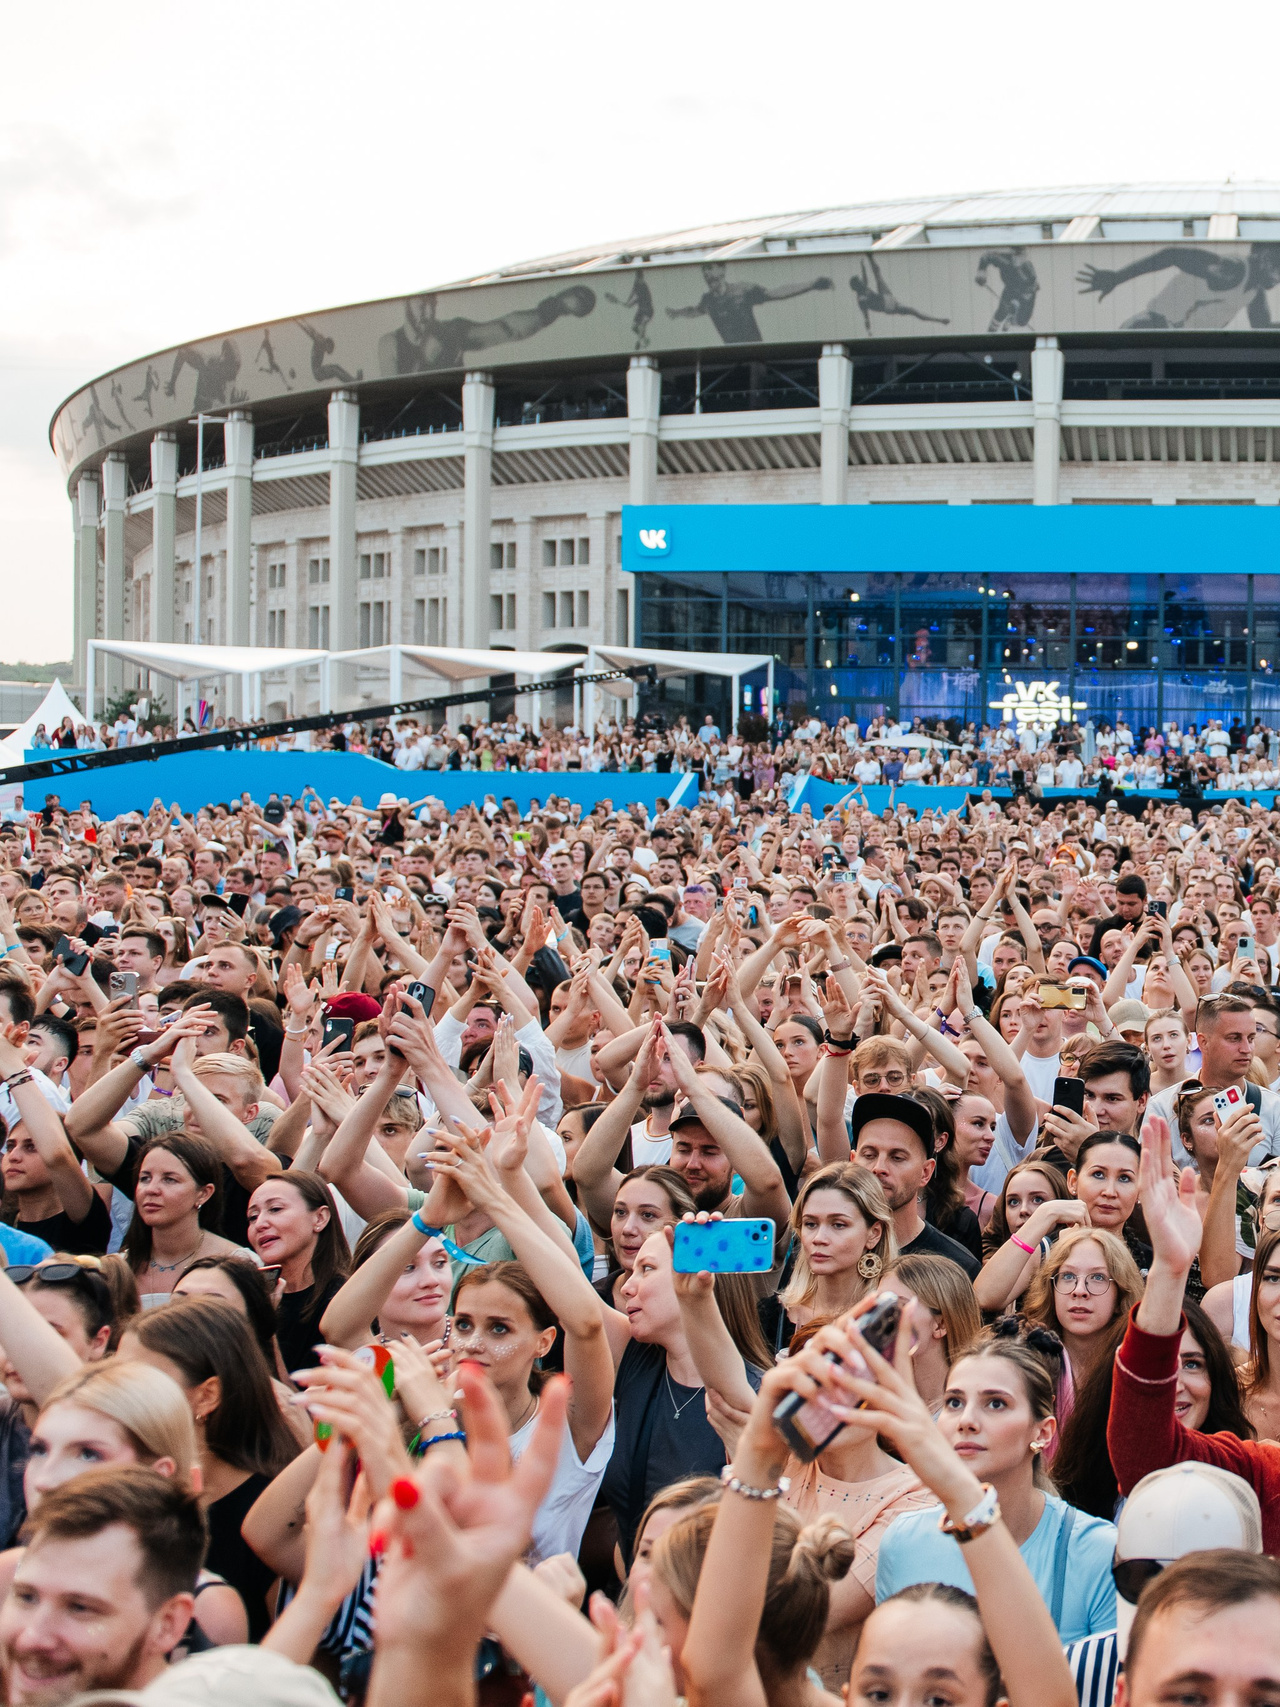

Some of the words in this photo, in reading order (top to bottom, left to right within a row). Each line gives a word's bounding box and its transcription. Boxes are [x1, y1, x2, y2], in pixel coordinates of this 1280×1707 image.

[639, 529, 667, 549] VK
[1015, 681, 1060, 702] VK
[989, 693, 1087, 723] fest
